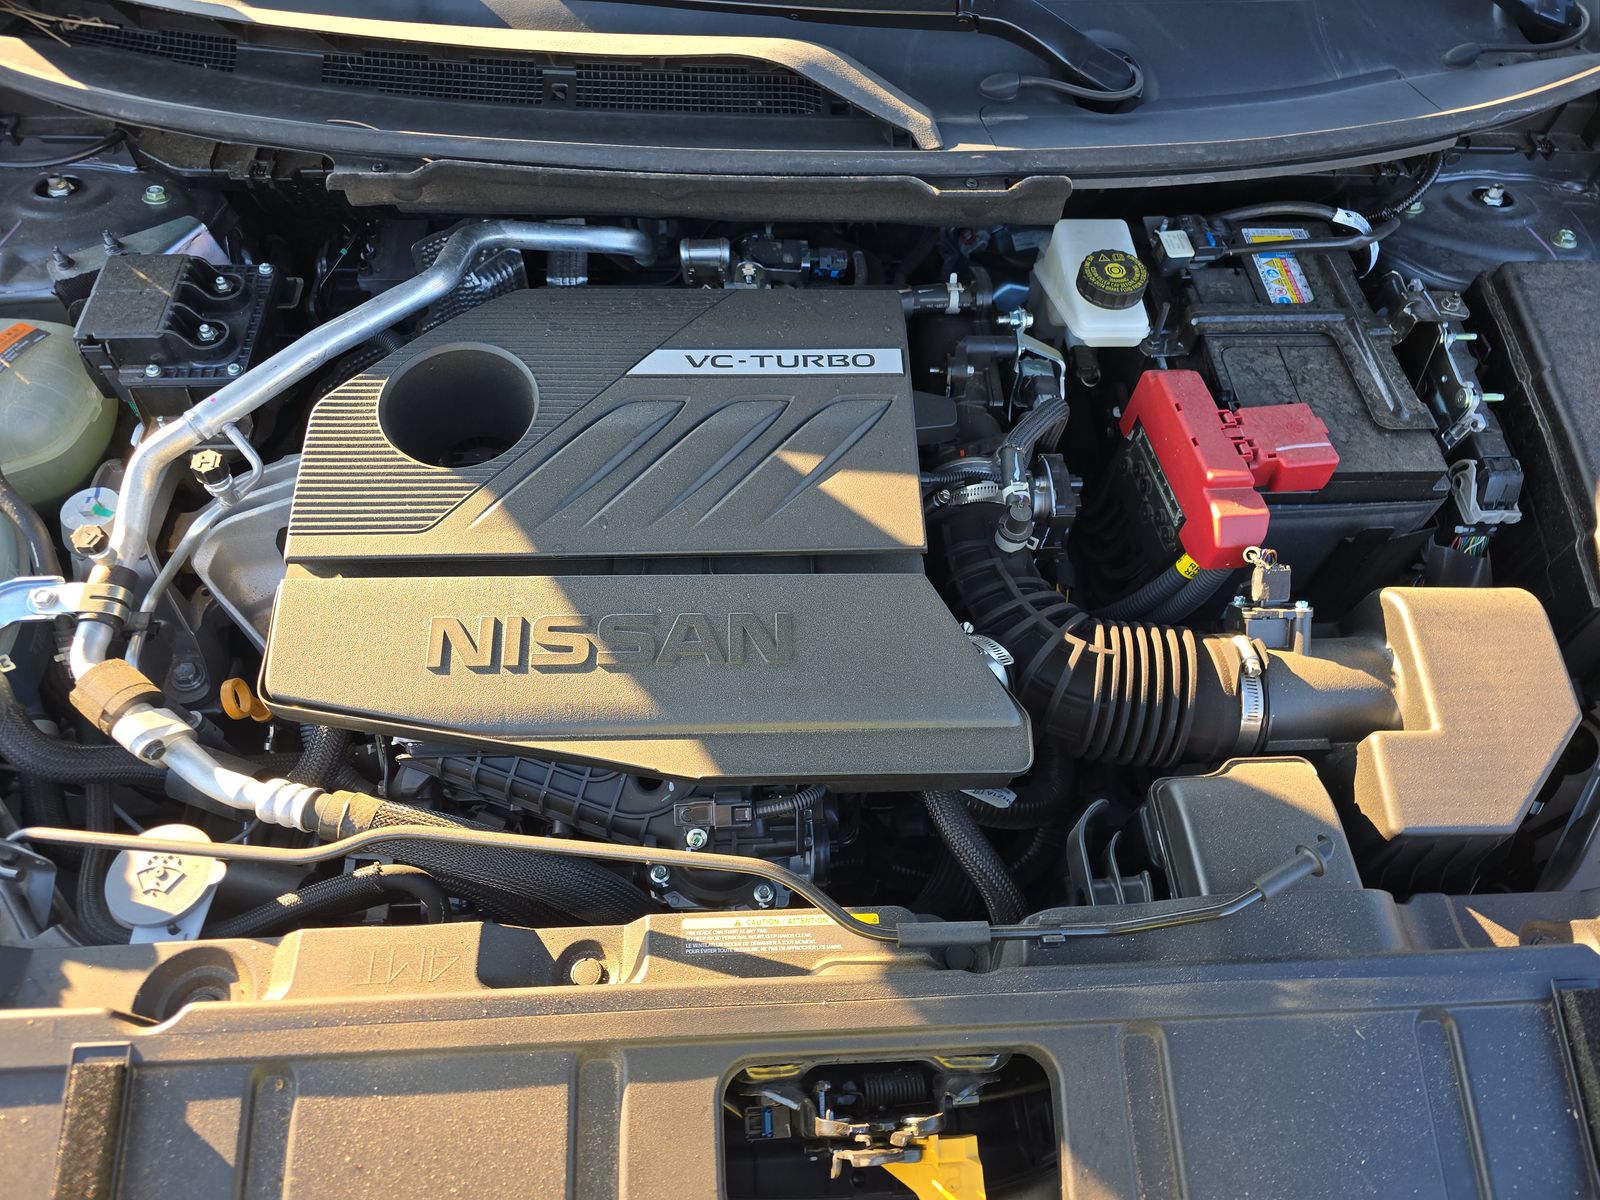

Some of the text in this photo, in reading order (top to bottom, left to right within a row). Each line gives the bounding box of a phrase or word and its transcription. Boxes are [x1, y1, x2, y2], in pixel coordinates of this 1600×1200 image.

[685, 353, 876, 368] VC-TURBO
[426, 612, 793, 674] NISSAN
[746, 918, 779, 926] CAUTION
[787, 917, 828, 925] ATTENTION
